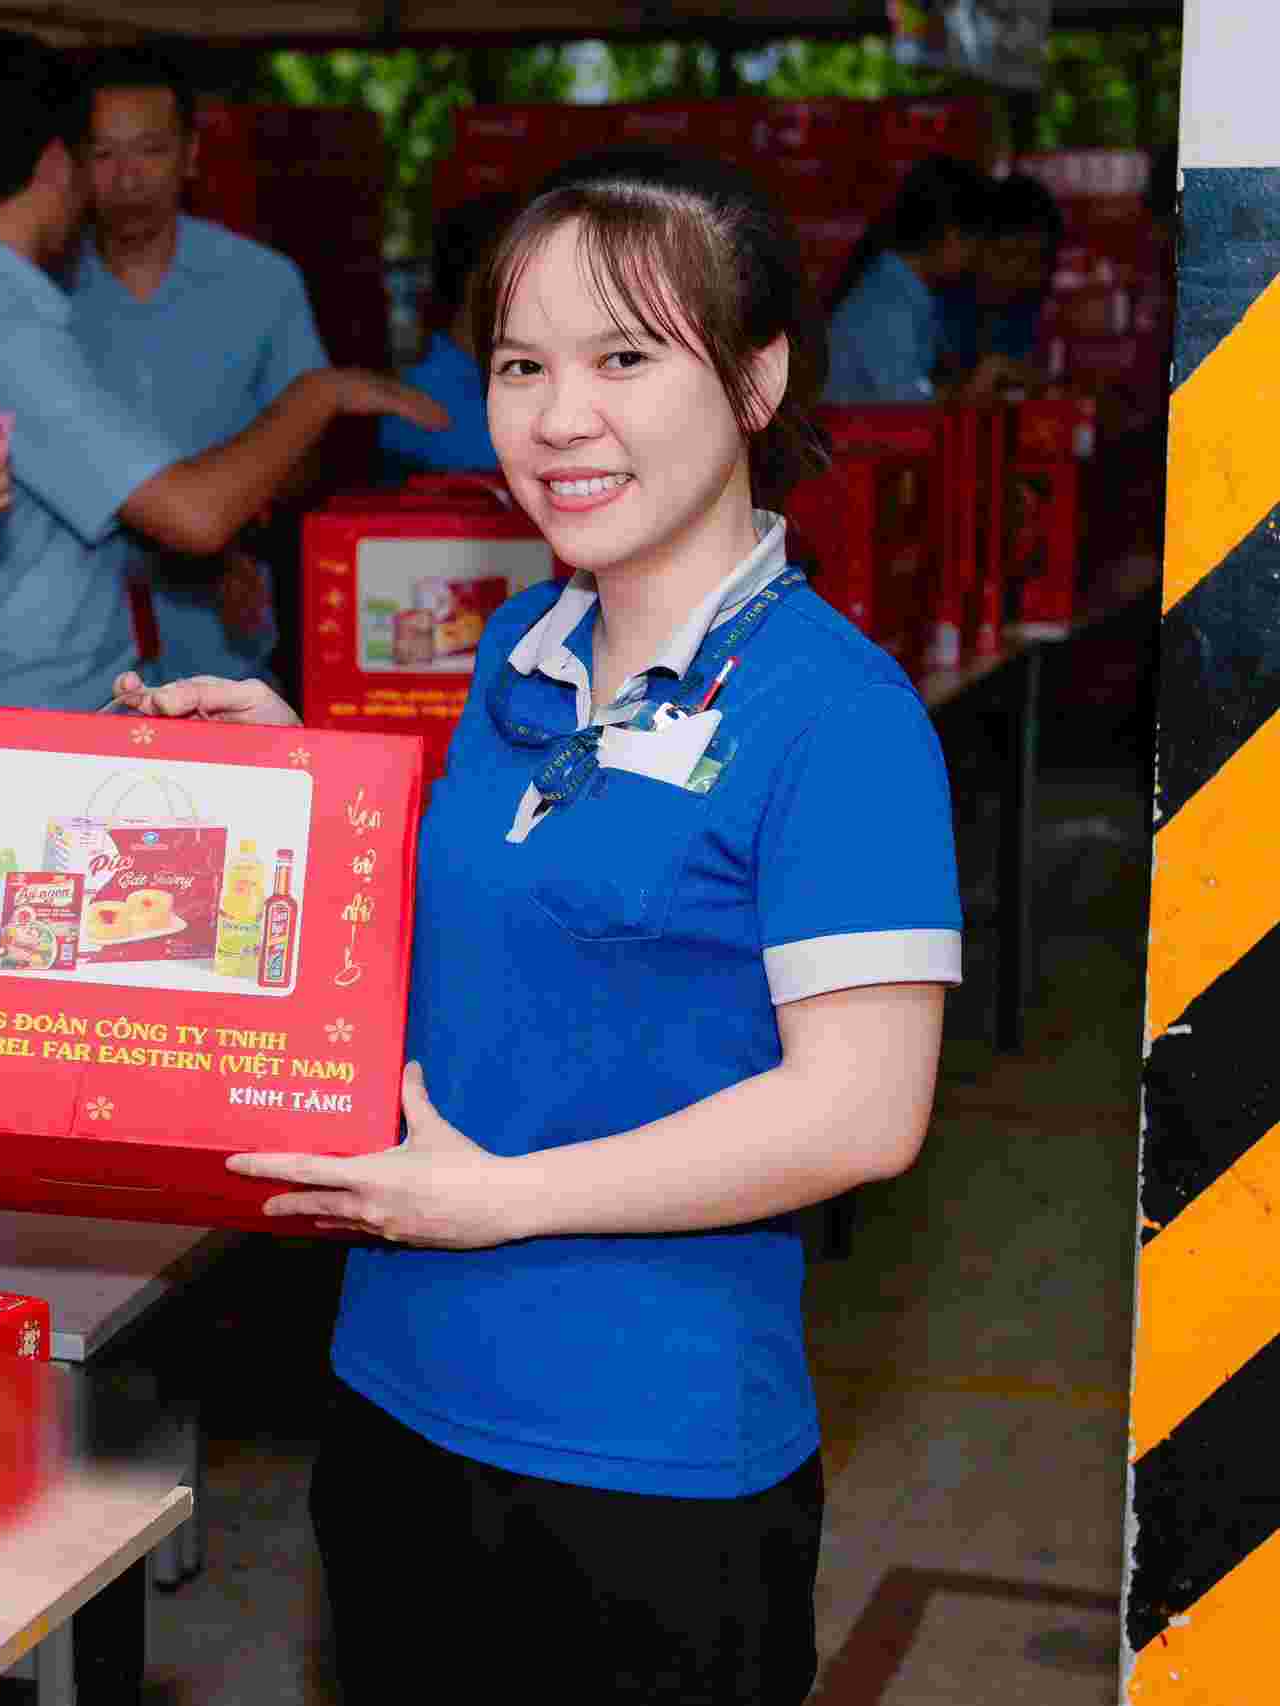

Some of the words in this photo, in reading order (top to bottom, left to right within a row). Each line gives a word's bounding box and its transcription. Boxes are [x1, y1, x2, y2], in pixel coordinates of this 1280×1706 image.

[13, 1011, 88, 1036] ĐOÀN
[95, 1016, 168, 1042] CÔNG
[175, 1025, 209, 1045] TY
[215, 1028, 288, 1051] TNHH
[41, 1039, 91, 1062] FAR
[96, 1045, 214, 1072] EASTERN
[219, 1051, 286, 1080] (VIỆT
[289, 1058, 356, 1084] NAM)
[228, 1085, 285, 1107] KÍNH
